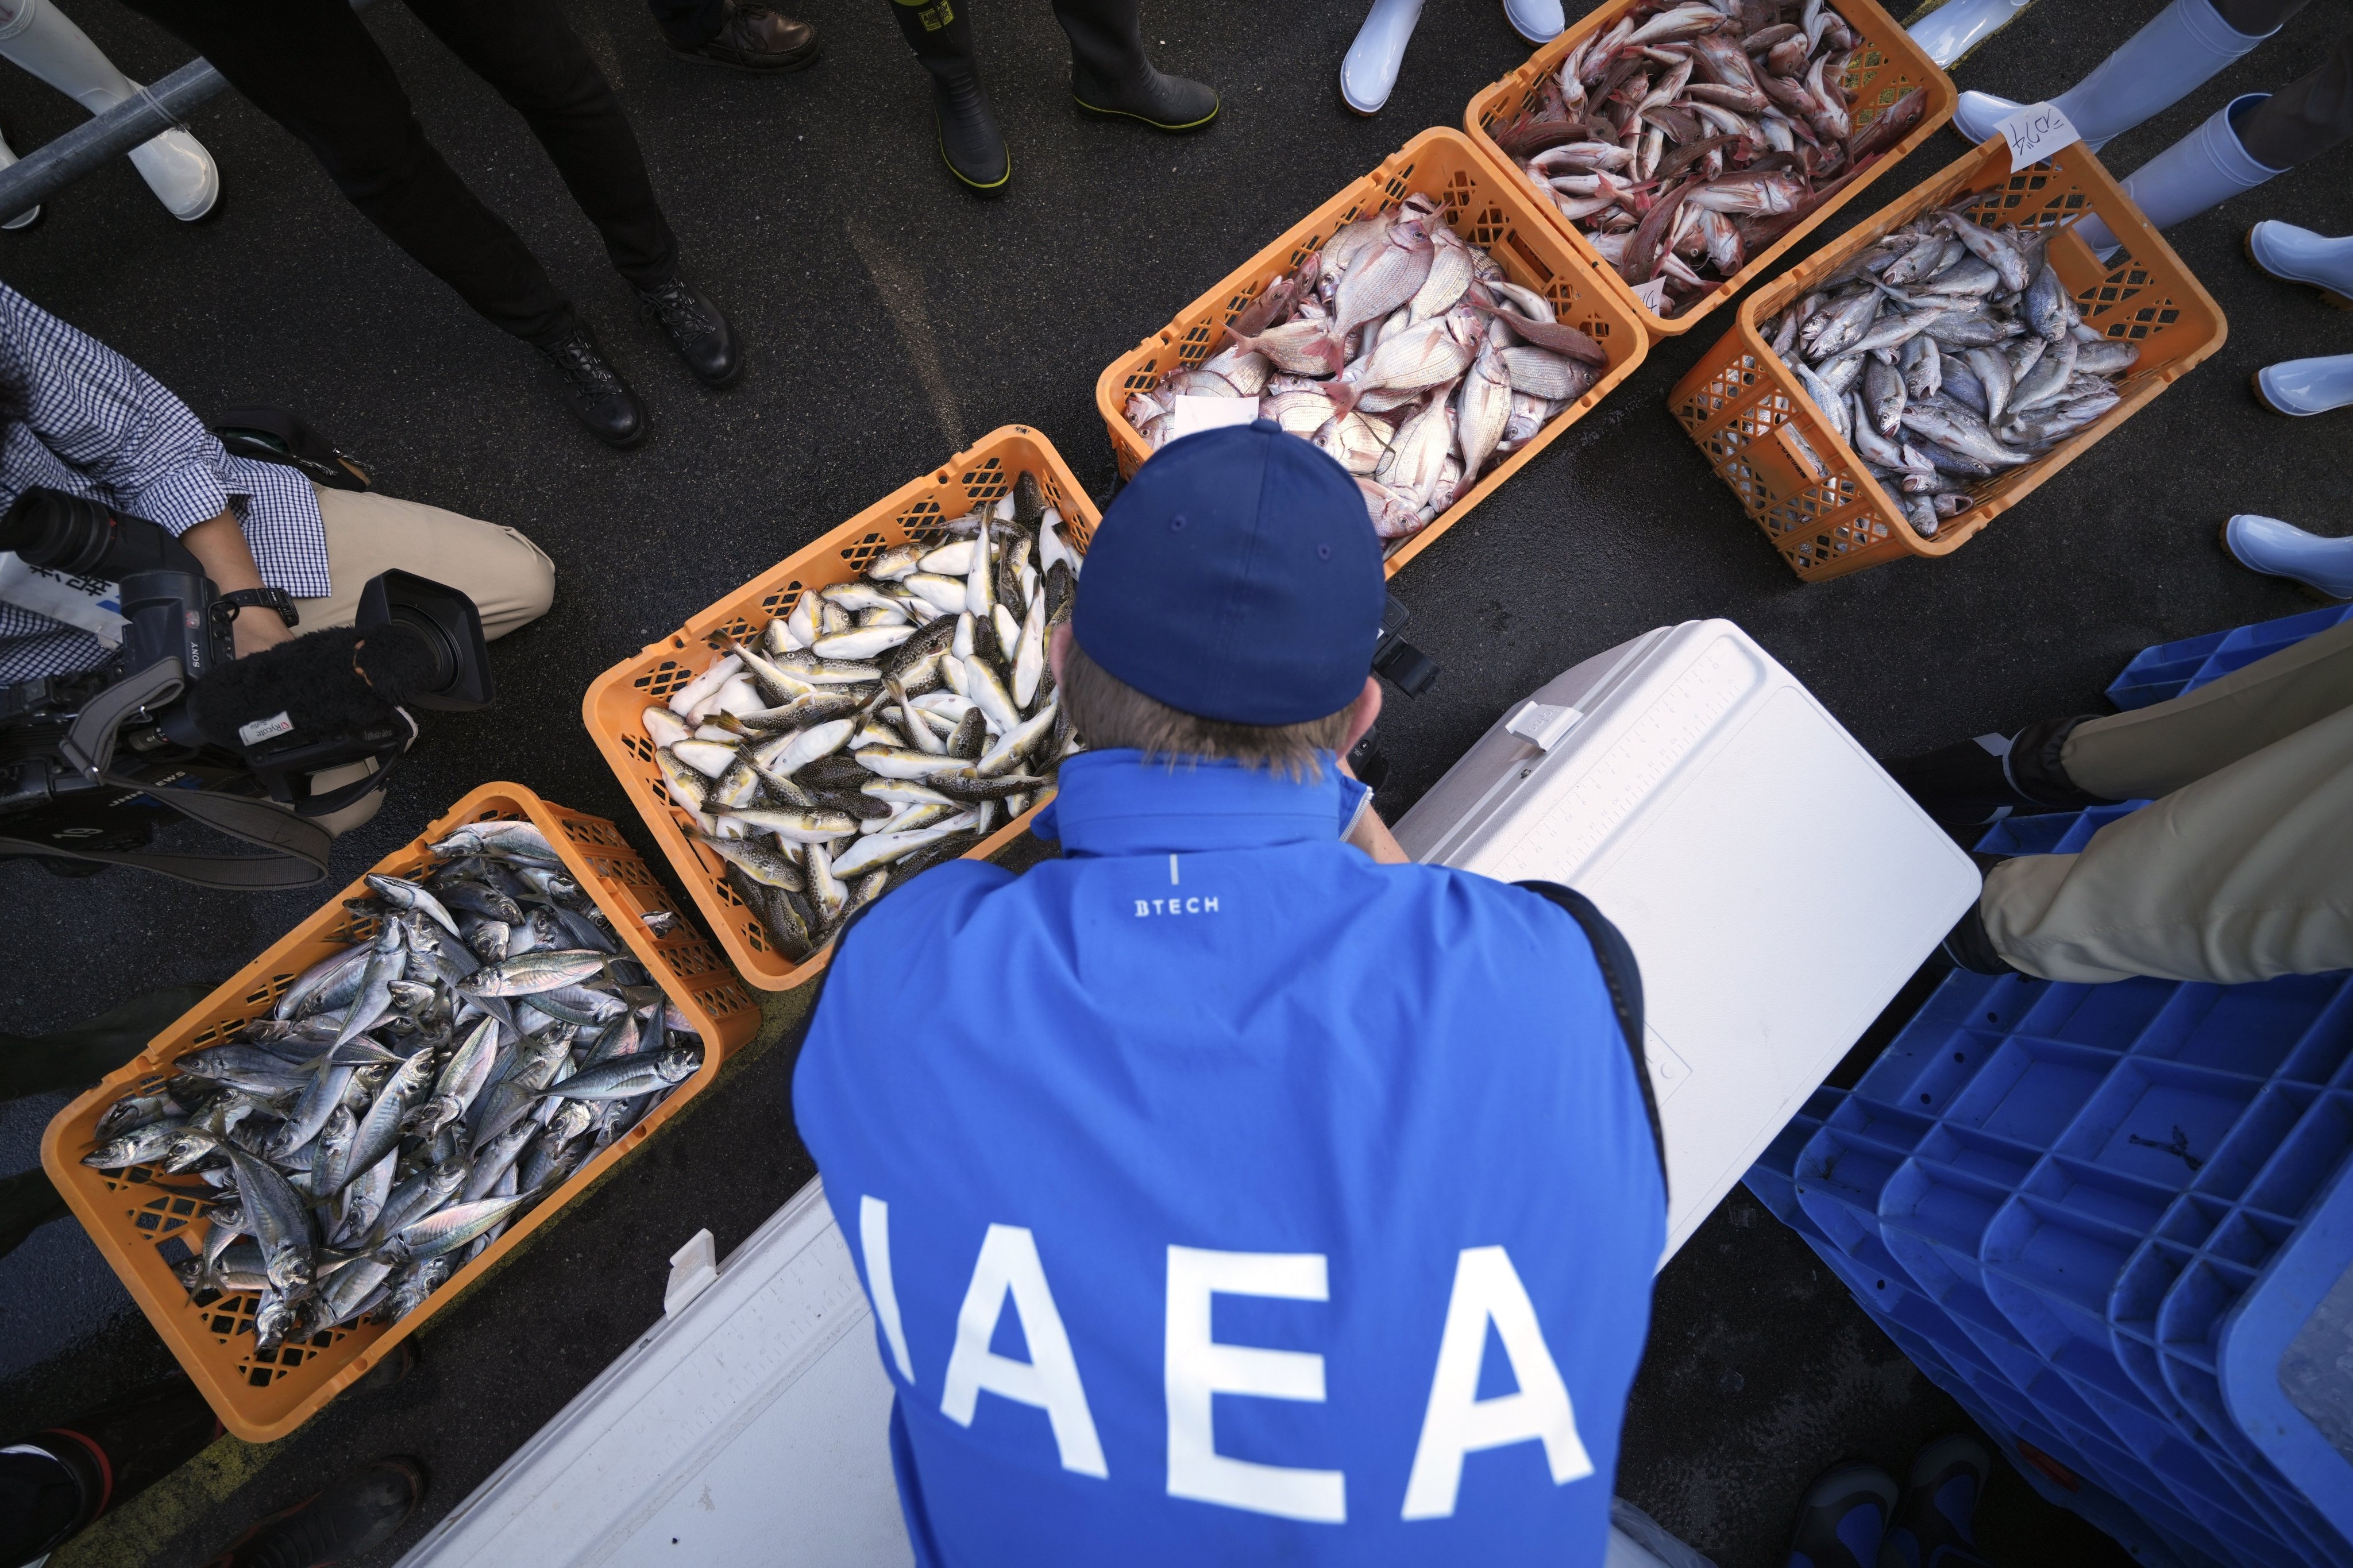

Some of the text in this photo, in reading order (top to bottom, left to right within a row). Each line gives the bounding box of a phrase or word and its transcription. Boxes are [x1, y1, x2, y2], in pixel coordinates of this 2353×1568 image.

[192, 641, 200, 669] SONY
[249, 720, 267, 729] Softie
[256, 723, 283, 737] Rycote
[108, 790, 144, 808] JNN
[51, 828, 104, 839] 19
[1134, 895, 1220, 918] BTECH
[859, 1194, 1595, 1525] IAEA
